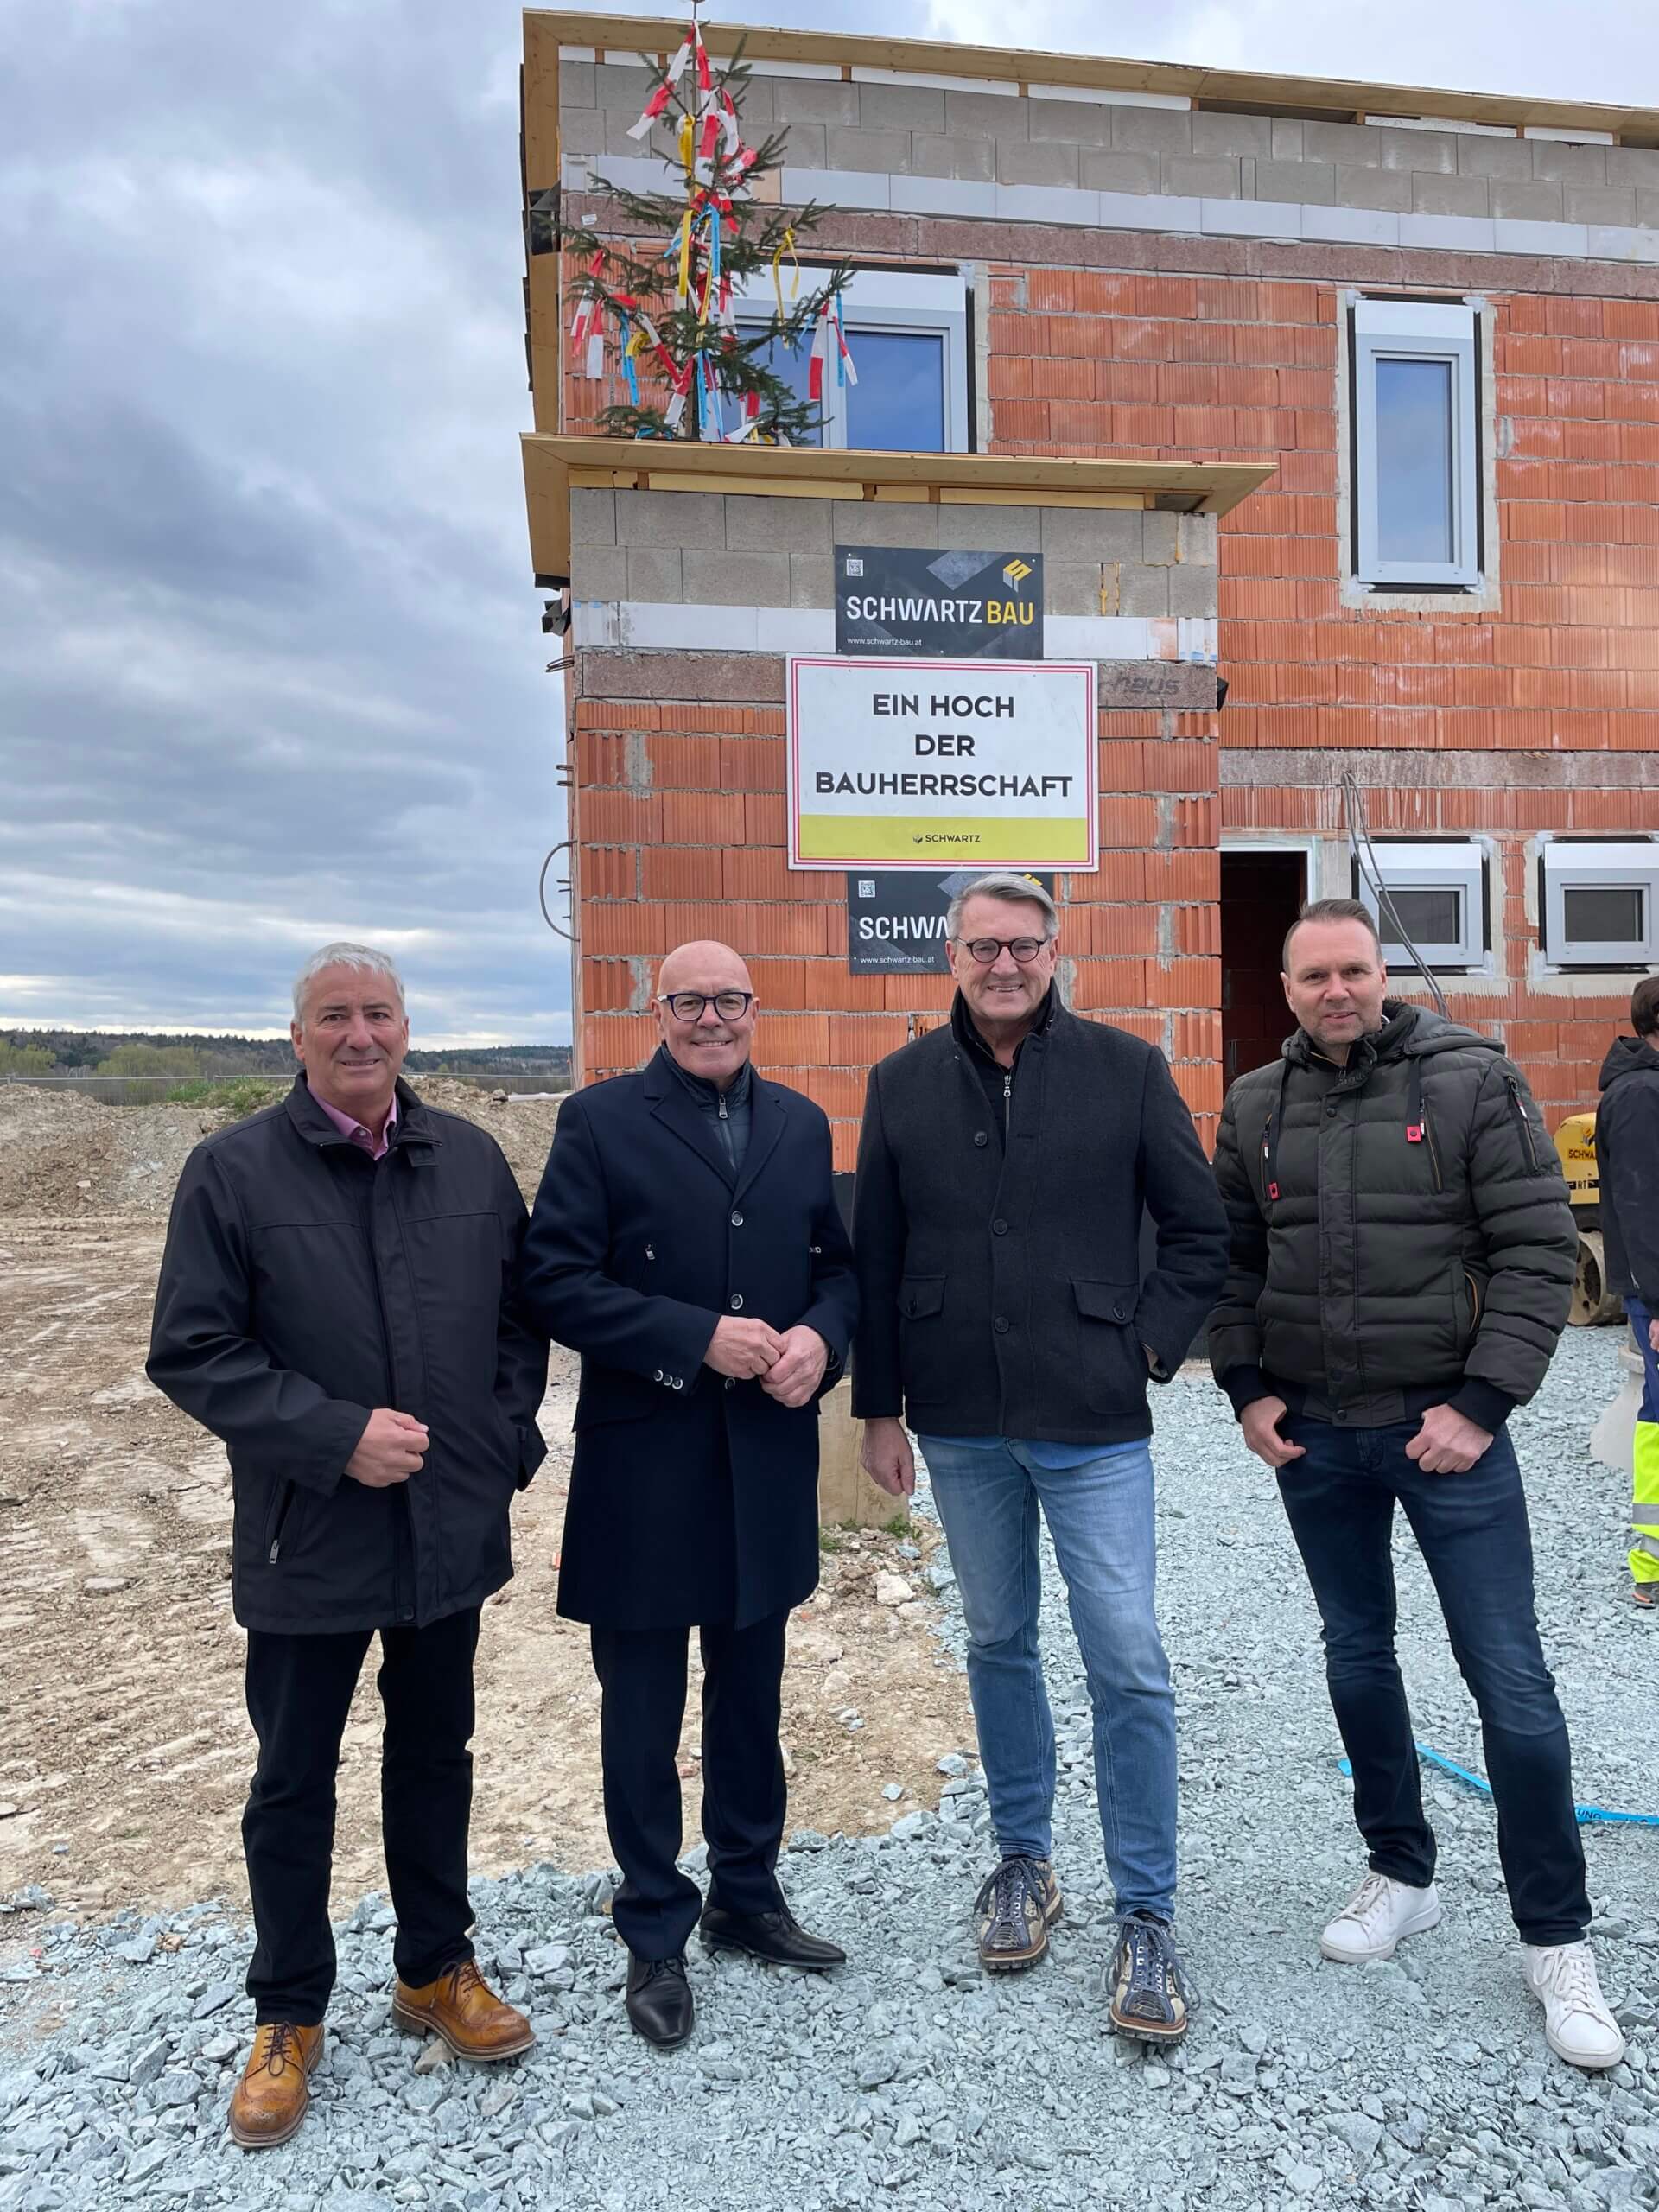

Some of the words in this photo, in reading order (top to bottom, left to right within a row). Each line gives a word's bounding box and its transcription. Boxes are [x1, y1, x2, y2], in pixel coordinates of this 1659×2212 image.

[846, 595, 982, 624] SCHWARTZ
[987, 601, 1034, 626] BAU
[846, 637, 923, 646] www.schwartz-bau.at
[873, 693, 919, 716] EIN
[931, 695, 1014, 718] HOCH
[915, 734, 976, 757] DER
[816, 772, 1073, 798] BAUHERRSCHAFT
[925, 834, 982, 844] SCHWARTZ
[859, 916, 950, 940] SCHWA
[860, 956, 935, 965] www.schwartz-bau.at
[1568, 1149, 1595, 1159] SCHWA
